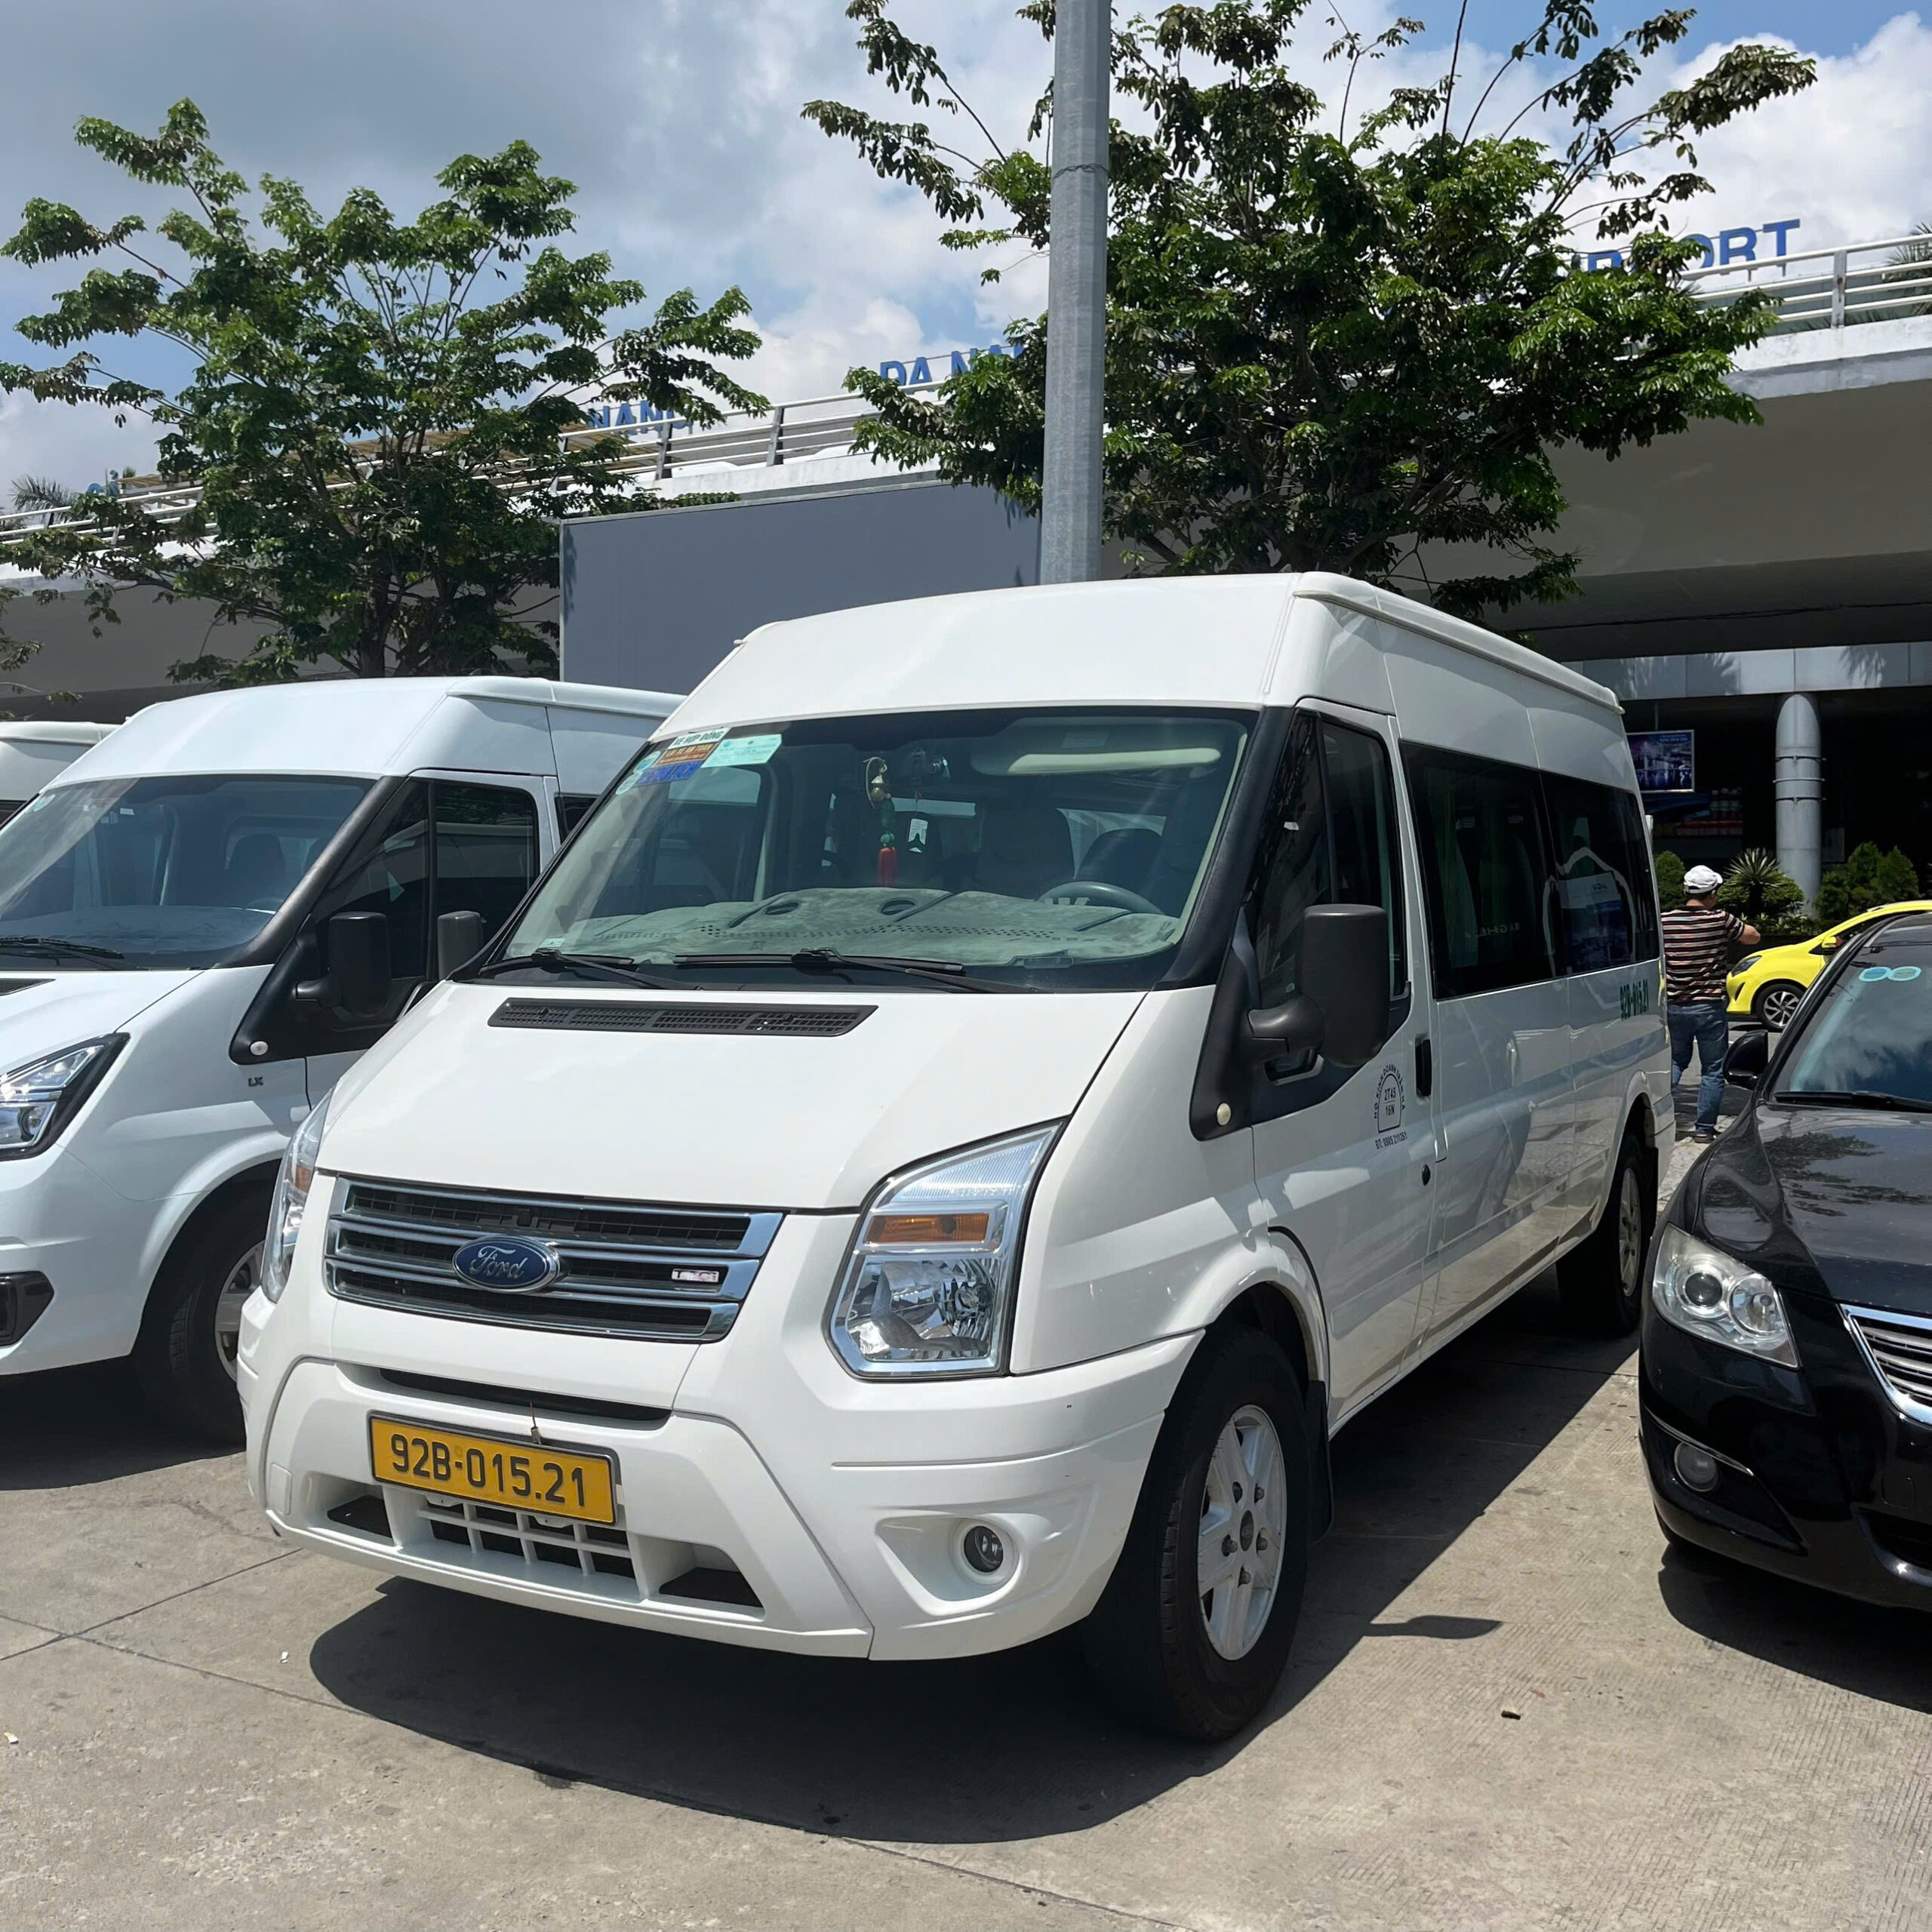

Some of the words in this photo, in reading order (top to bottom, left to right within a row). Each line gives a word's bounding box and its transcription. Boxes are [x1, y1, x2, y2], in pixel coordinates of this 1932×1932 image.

[248, 1076, 264, 1087] LX
[469, 1245, 528, 1279] Ford
[390, 1433, 585, 1507] 92B-015.21
